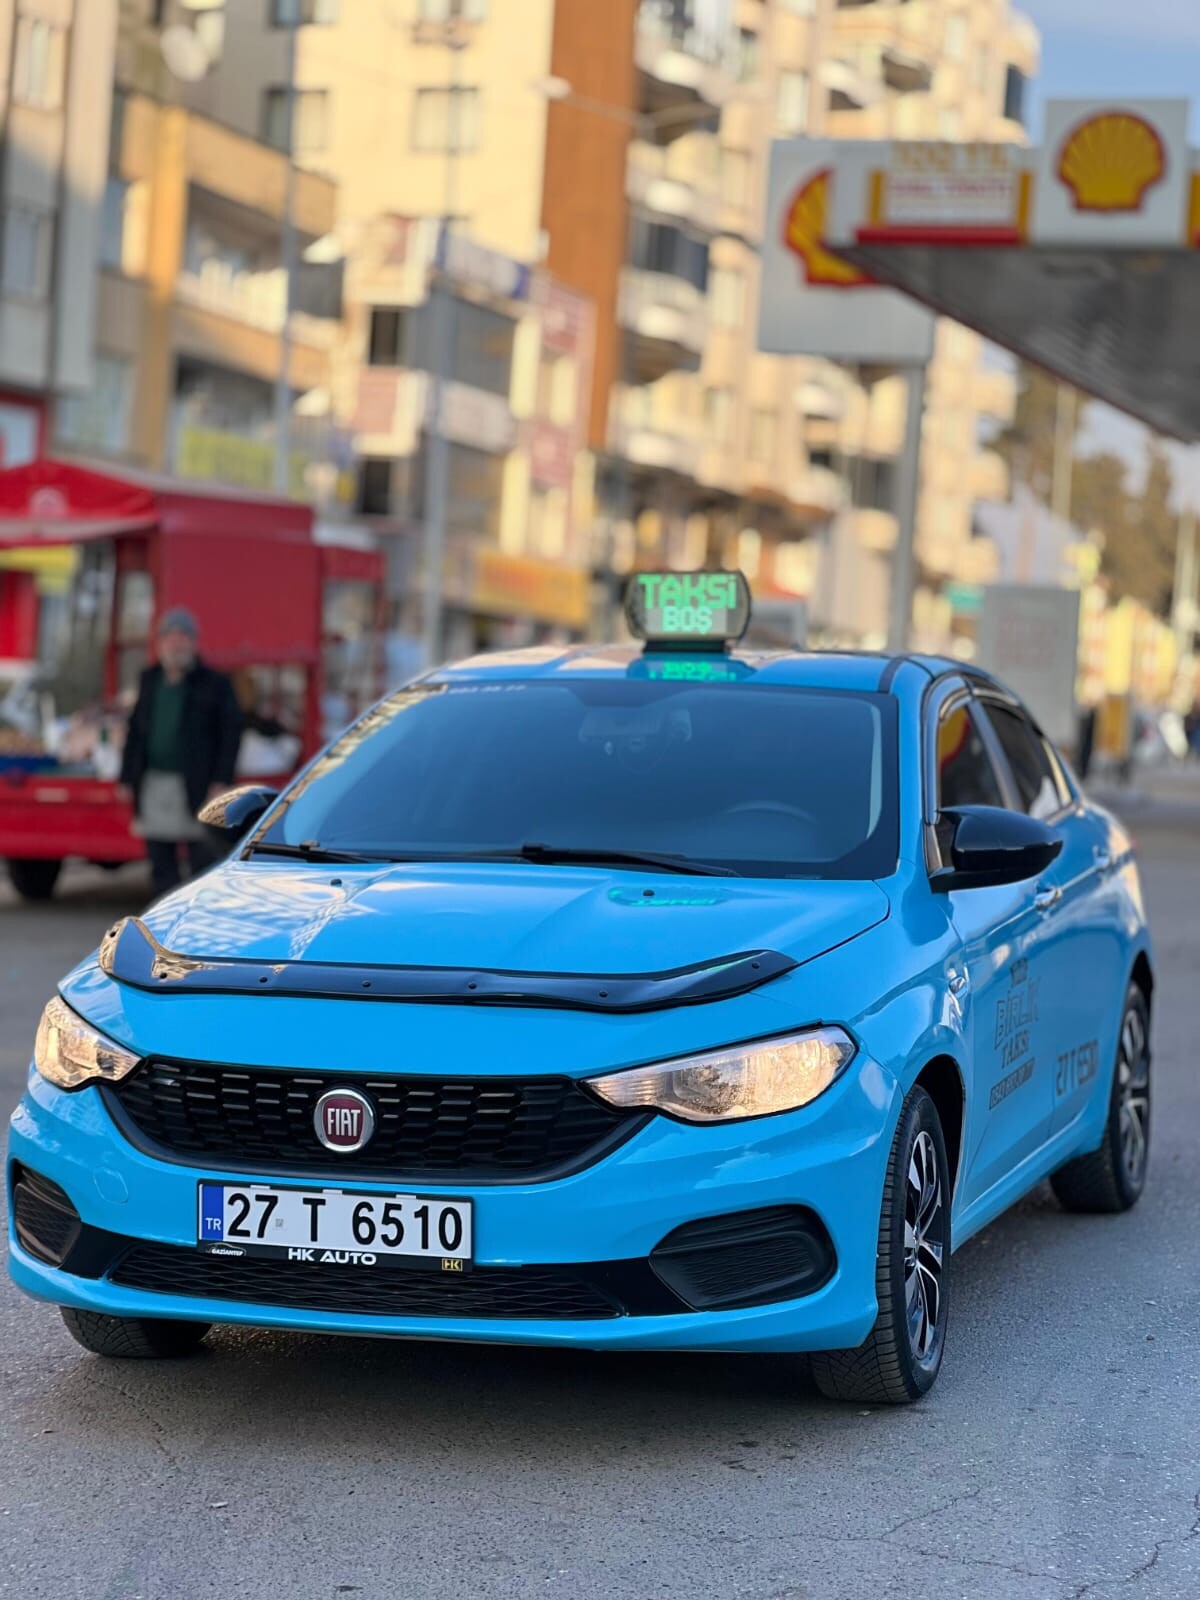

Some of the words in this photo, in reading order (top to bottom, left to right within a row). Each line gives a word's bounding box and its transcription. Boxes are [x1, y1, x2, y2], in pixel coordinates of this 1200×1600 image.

[327, 1107, 361, 1137] FIAT
[205, 1217, 221, 1231] TR
[227, 1192, 279, 1239] 27
[302, 1197, 326, 1242] T
[352, 1201, 463, 1251] 6510
[288, 1248, 314, 1262] HK
[319, 1251, 377, 1265] AUTO
[444, 1260, 461, 1270] HK
